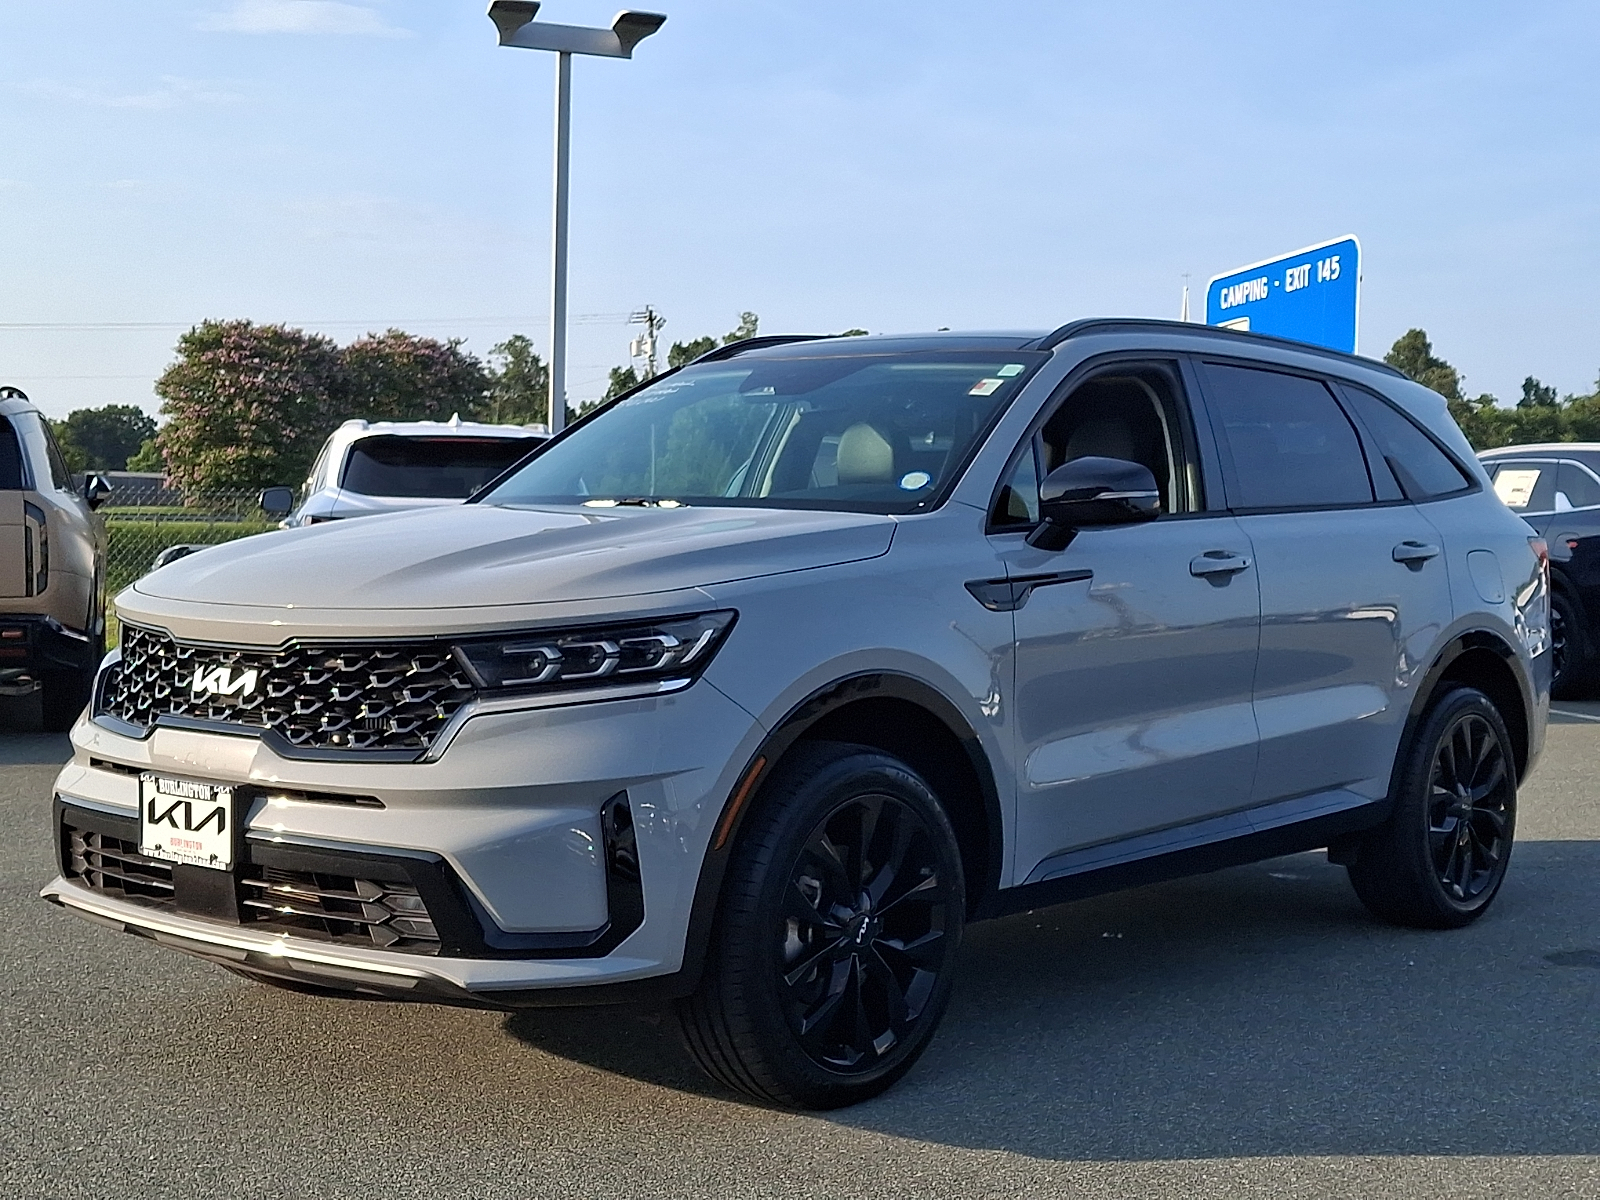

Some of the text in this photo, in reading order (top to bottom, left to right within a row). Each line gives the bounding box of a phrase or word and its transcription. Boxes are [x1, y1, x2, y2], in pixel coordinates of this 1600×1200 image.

[1220, 276, 1269, 310] CAMPING
[1285, 263, 1312, 293] EXIT
[1316, 255, 1341, 283] 145
[192, 664, 258, 697] KIA
[158, 778, 211, 801] BURLINGTON
[148, 797, 226, 836] KIA
[170, 837, 203, 851] BURLINGTON
